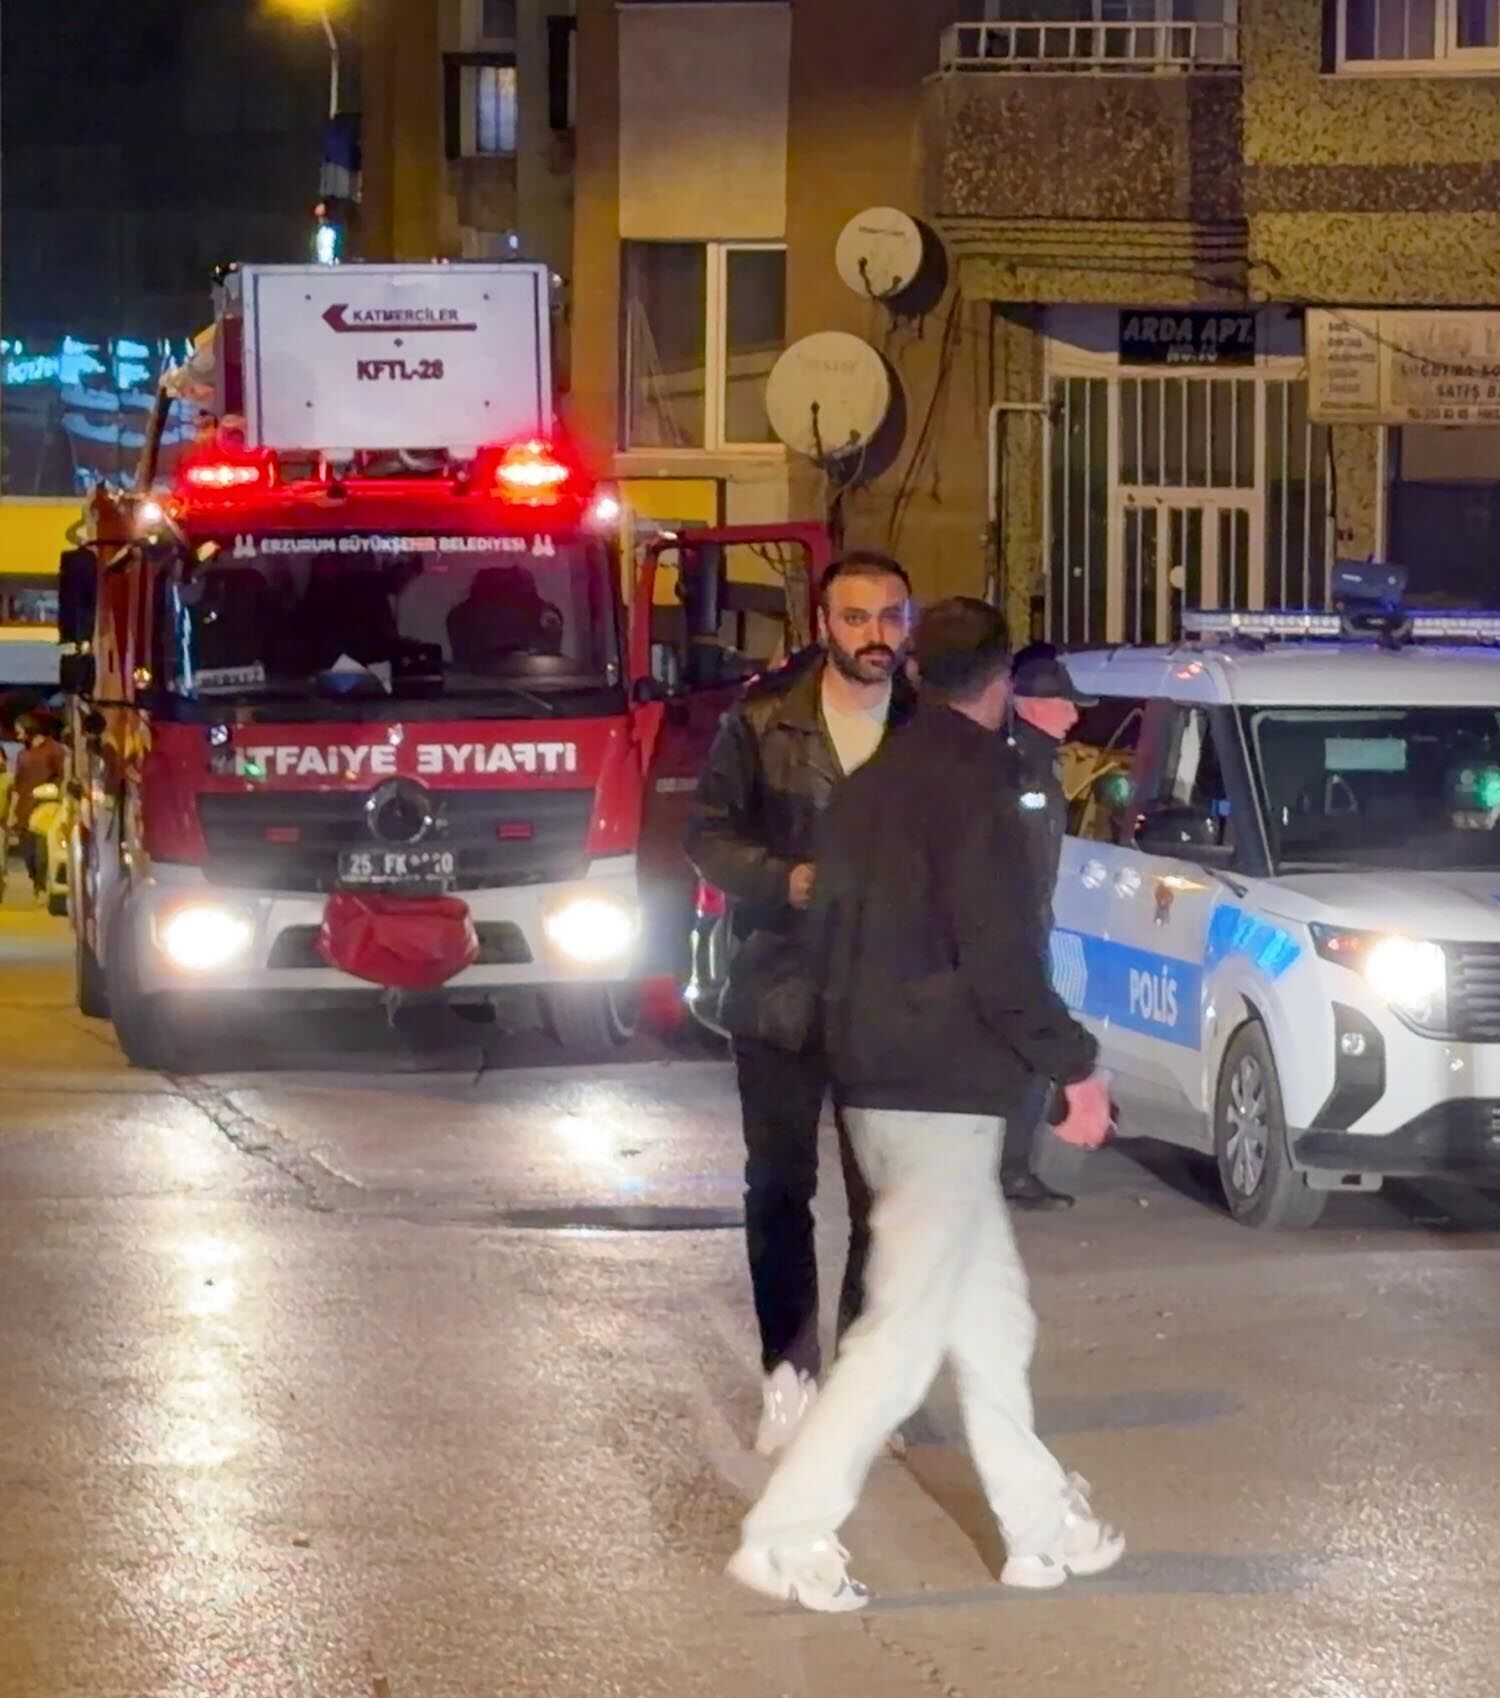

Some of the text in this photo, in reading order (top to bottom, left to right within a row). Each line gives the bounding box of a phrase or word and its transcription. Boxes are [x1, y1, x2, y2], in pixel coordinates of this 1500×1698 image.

[352, 308, 459, 322] KATMERCİLER
[1123, 316, 1193, 343] ARDA
[356, 359, 444, 380] KFTL-28
[1129, 964, 1178, 1027] POLİS
